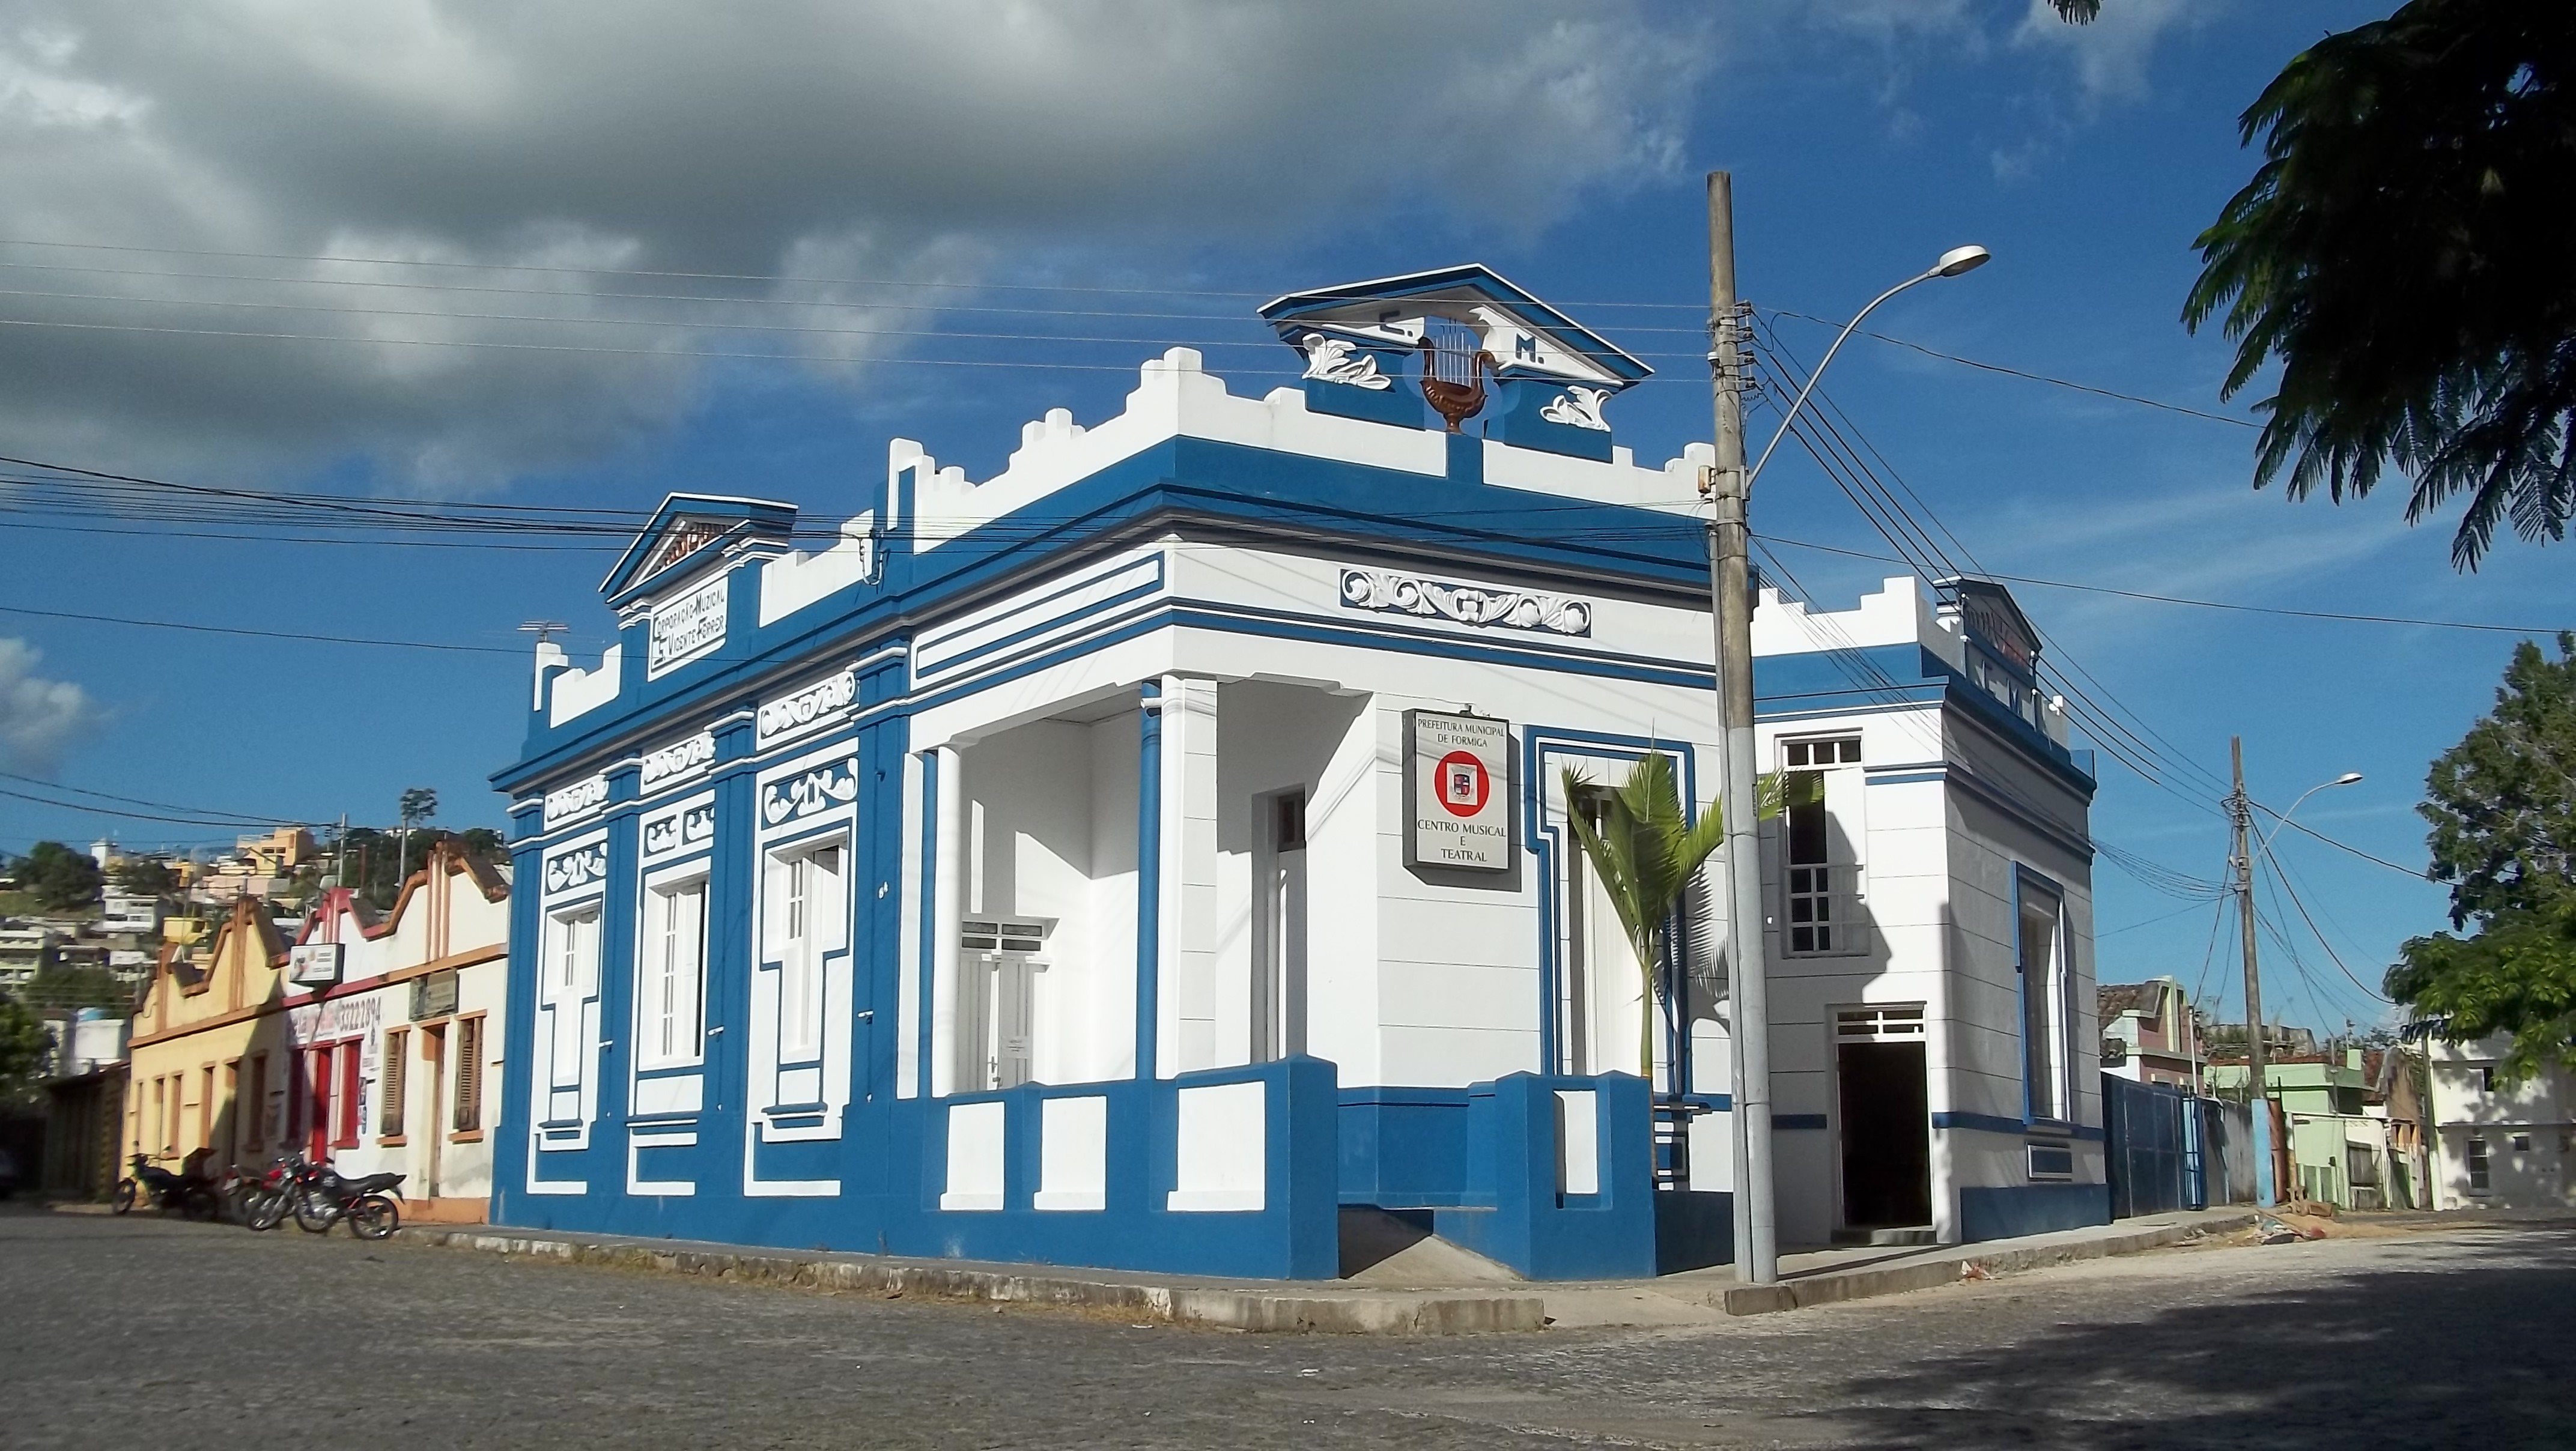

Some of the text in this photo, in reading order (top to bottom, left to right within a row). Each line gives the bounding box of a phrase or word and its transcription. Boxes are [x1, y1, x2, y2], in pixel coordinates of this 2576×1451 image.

[1515, 333, 1545, 365] M.
[1418, 718, 1505, 738] PREFEITURA MUNICIPAL
[1438, 733, 1488, 747] DE FORMIGA
[1418, 819, 1506, 837] CENTRO MUSICAL
[1460, 836, 1466, 846] E
[1441, 849, 1487, 862] TEATRAL
